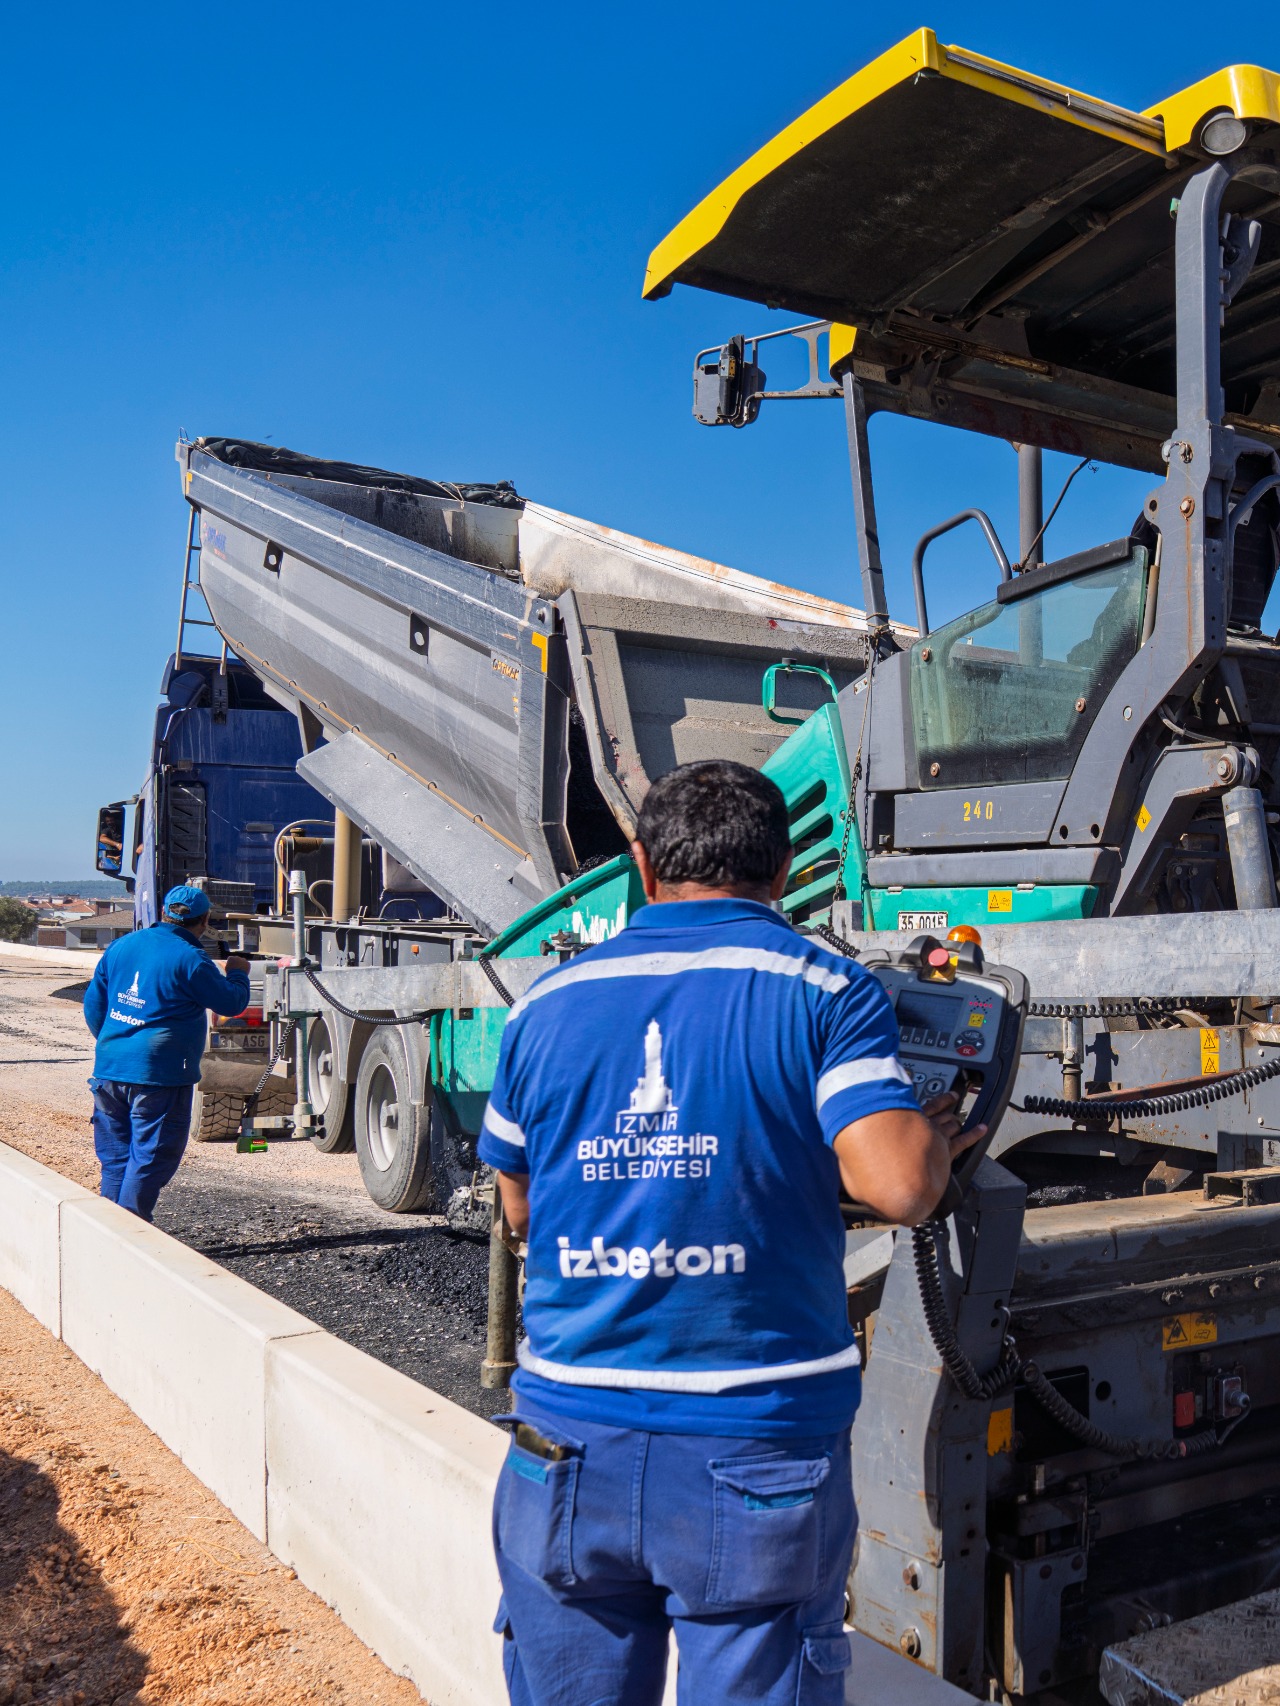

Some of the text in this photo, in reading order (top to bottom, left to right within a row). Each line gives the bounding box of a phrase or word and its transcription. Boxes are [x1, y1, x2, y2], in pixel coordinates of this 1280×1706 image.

[963, 800, 993, 821] 240
[901, 915, 914, 930] 35
[109, 1008, 146, 1026] izbeton
[242, 1035, 265, 1048] ASG
[615, 1112, 679, 1134] İZMİR
[577, 1132, 719, 1161] BÜYÜKŞEHİR
[583, 1157, 711, 1182] BELEDİYESİ
[557, 1236, 746, 1280] izbeton
